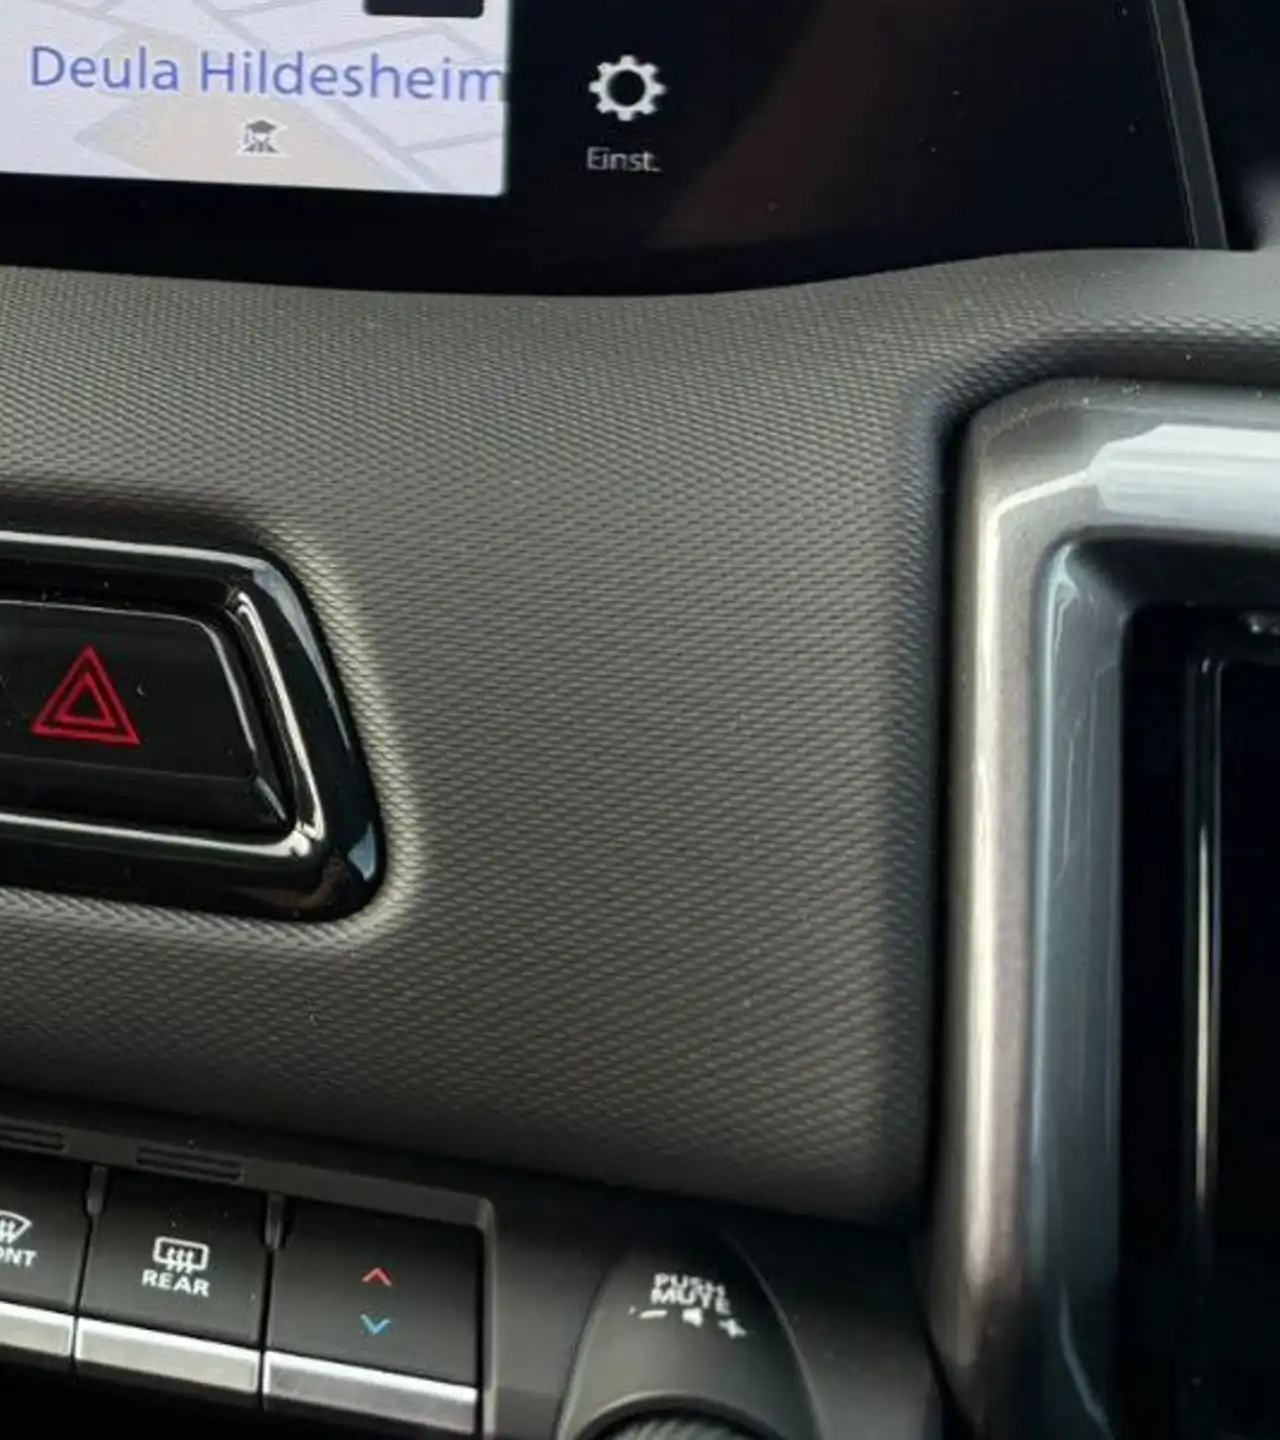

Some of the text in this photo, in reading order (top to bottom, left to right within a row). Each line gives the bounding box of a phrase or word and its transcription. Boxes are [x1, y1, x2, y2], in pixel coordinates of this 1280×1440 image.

[30, 44, 505, 103] Deula Hildesheim
[586, 144, 662, 173] Einst.
[142, 1268, 211, 1298] REAR
[653, 1272, 726, 1297] PUSH
[650, 1287, 731, 1316] MUTE
